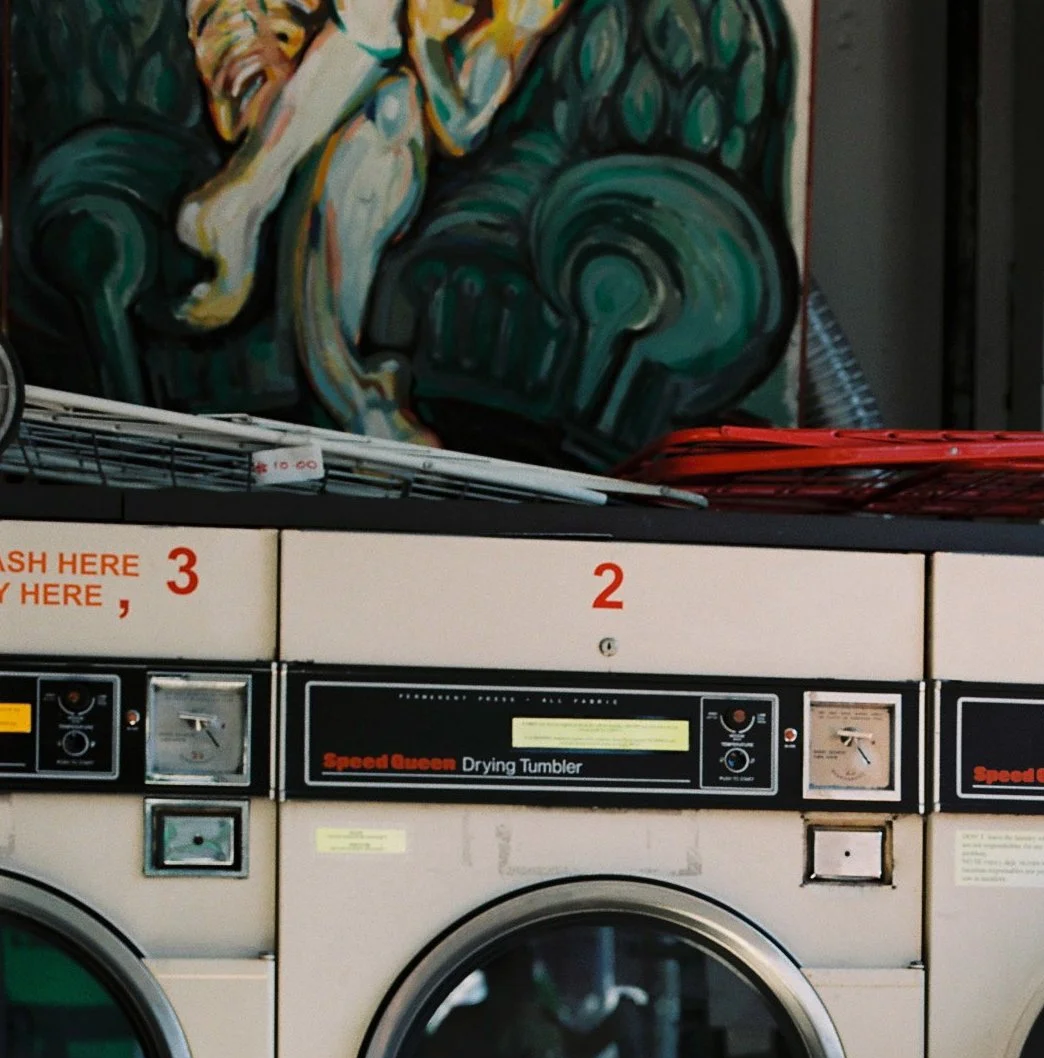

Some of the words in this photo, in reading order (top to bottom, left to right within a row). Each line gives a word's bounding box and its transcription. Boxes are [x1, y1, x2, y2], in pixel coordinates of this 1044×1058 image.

[58, 552, 140, 577] HERE
[166, 547, 199, 596] 3
[20, 582, 103, 607] HERE
[591, 562, 625, 611] 2
[323, 752, 389, 772] Speed
[390, 753, 457, 771] Queen
[462, 756, 516, 776] Drying
[519, 758, 583, 775] Tumbler
[973, 766, 1035, 785] Speed
